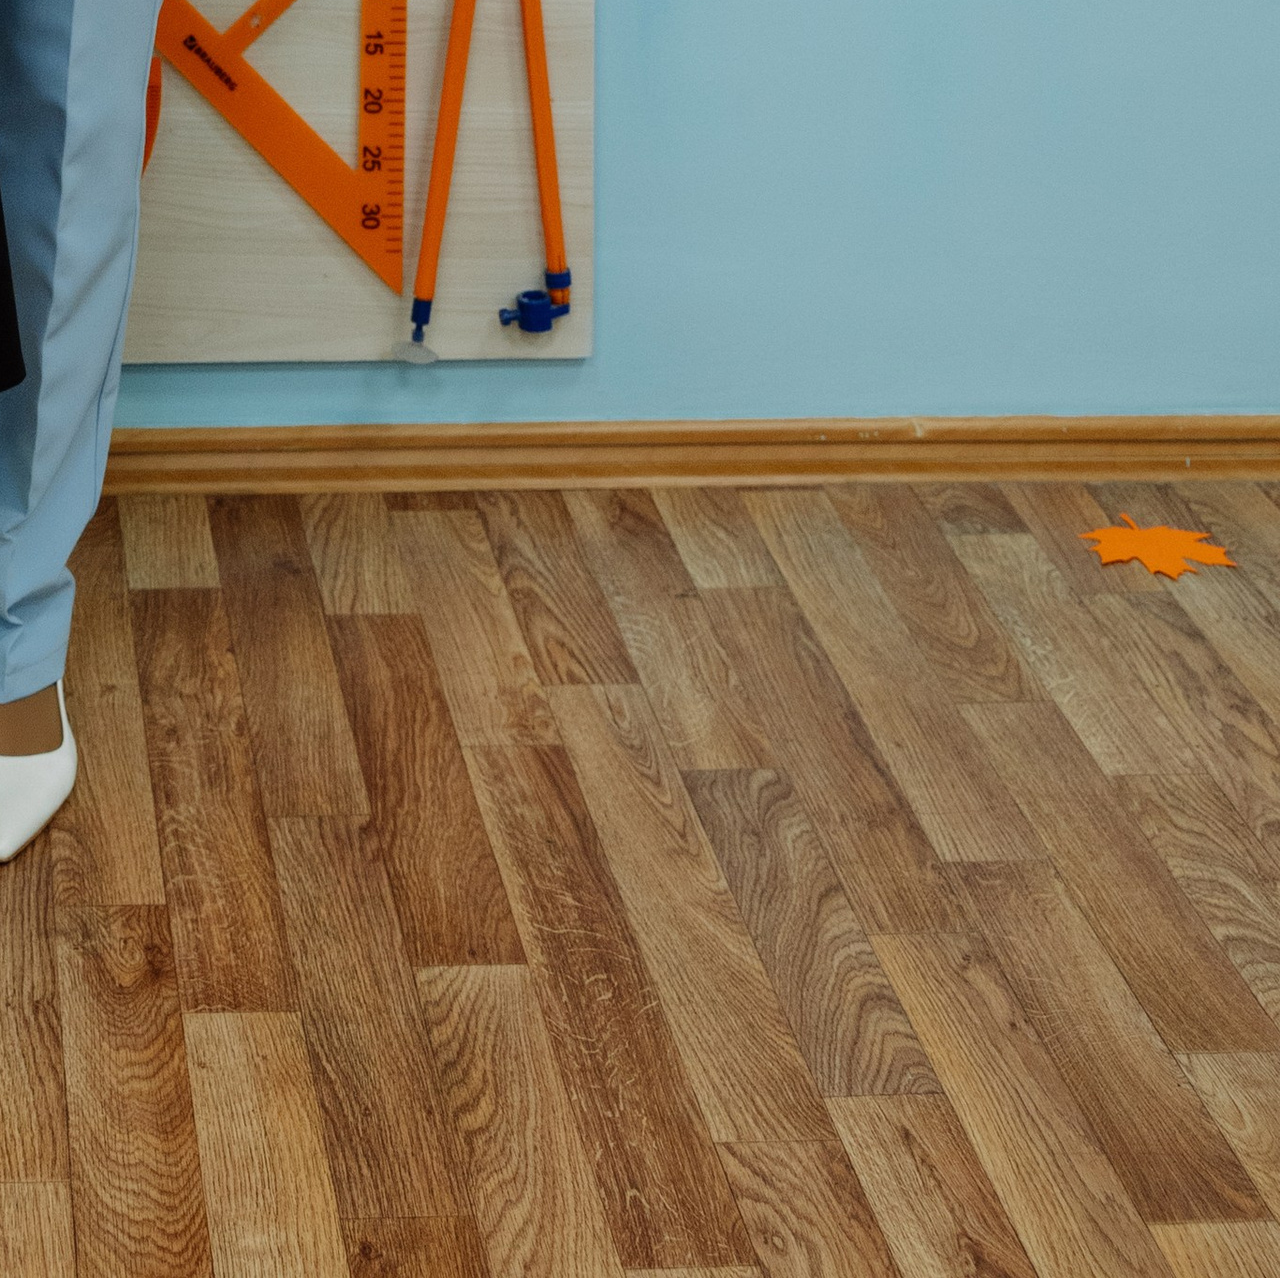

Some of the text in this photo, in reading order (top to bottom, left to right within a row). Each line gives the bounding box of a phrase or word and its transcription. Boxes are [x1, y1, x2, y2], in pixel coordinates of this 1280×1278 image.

[365, 30, 384, 56] 15
[363, 87, 383, 115] 20
[362, 145, 382, 173] 25
[360, 203, 381, 230] 30
